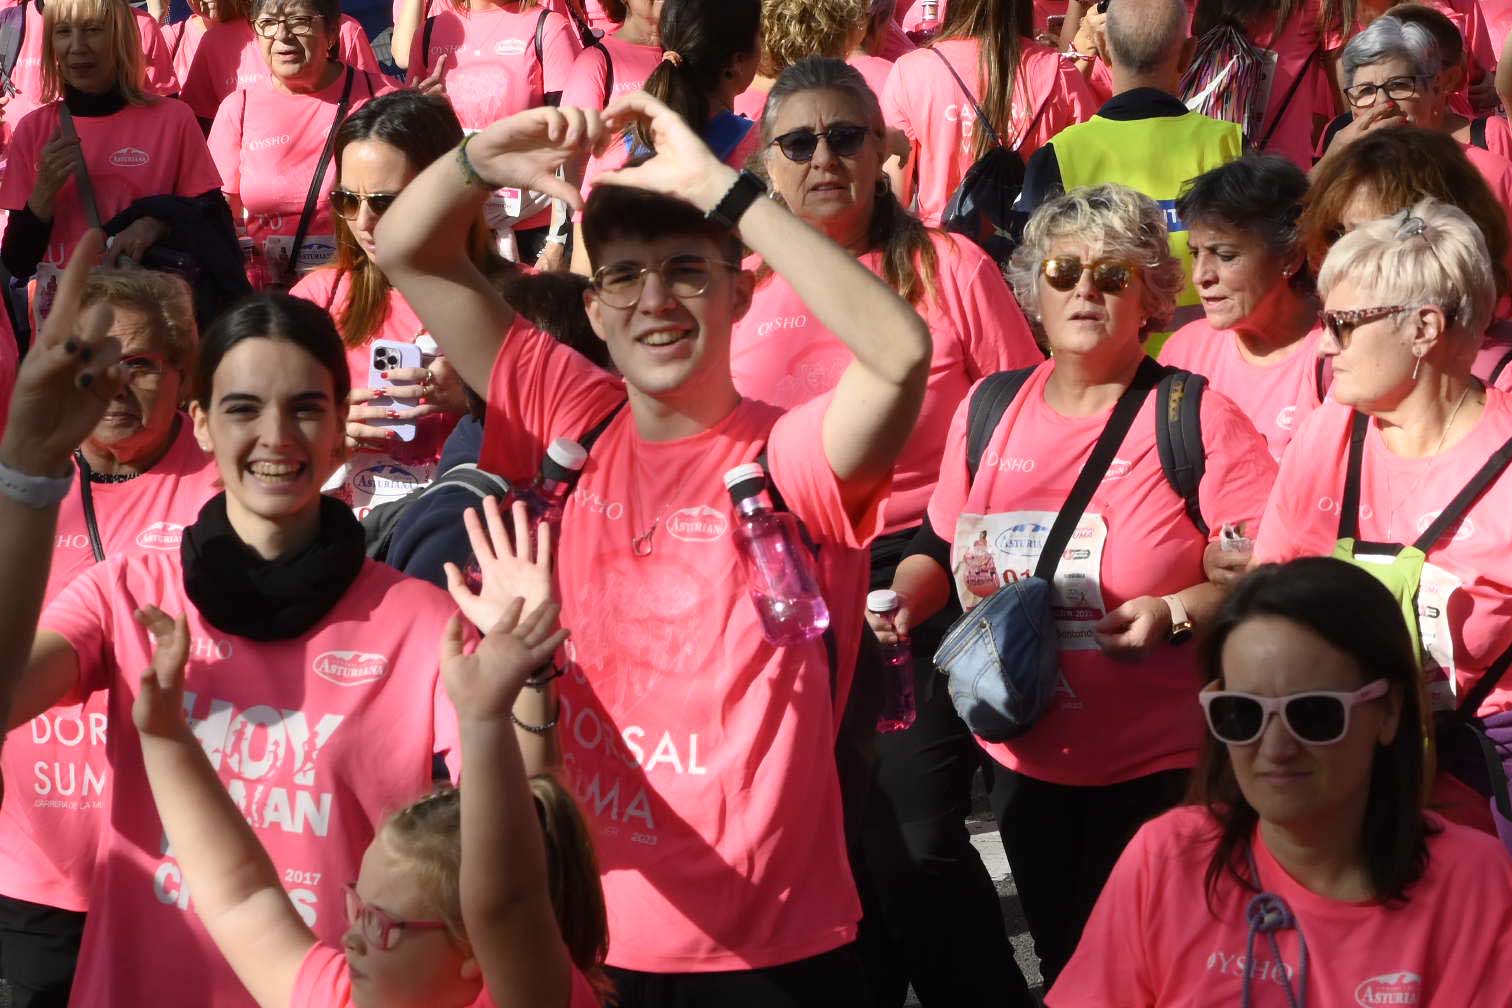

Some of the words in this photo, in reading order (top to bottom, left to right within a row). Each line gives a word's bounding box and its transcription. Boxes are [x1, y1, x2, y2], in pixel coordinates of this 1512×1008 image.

[613, 80, 645, 92] OYSH
[250, 134, 290, 152] OYSHO
[48, 243, 65, 267] U
[1318, 496, 1373, 520] OYO
[142, 535, 183, 543] ASTURIA
[1005, 535, 1042, 549] ASTURIA
[1073, 530, 1095, 539] UMA
[1003, 569, 1034, 584] 01
[1057, 629, 1093, 640] antand
[319, 658, 384, 677] ASTURIANA
[31, 712, 108, 746] DOR
[183, 692, 344, 786] HOY
[34, 761, 106, 796] SUM
[285, 868, 322, 885] 2017
[1363, 985, 1419, 1004] ASTURIA
